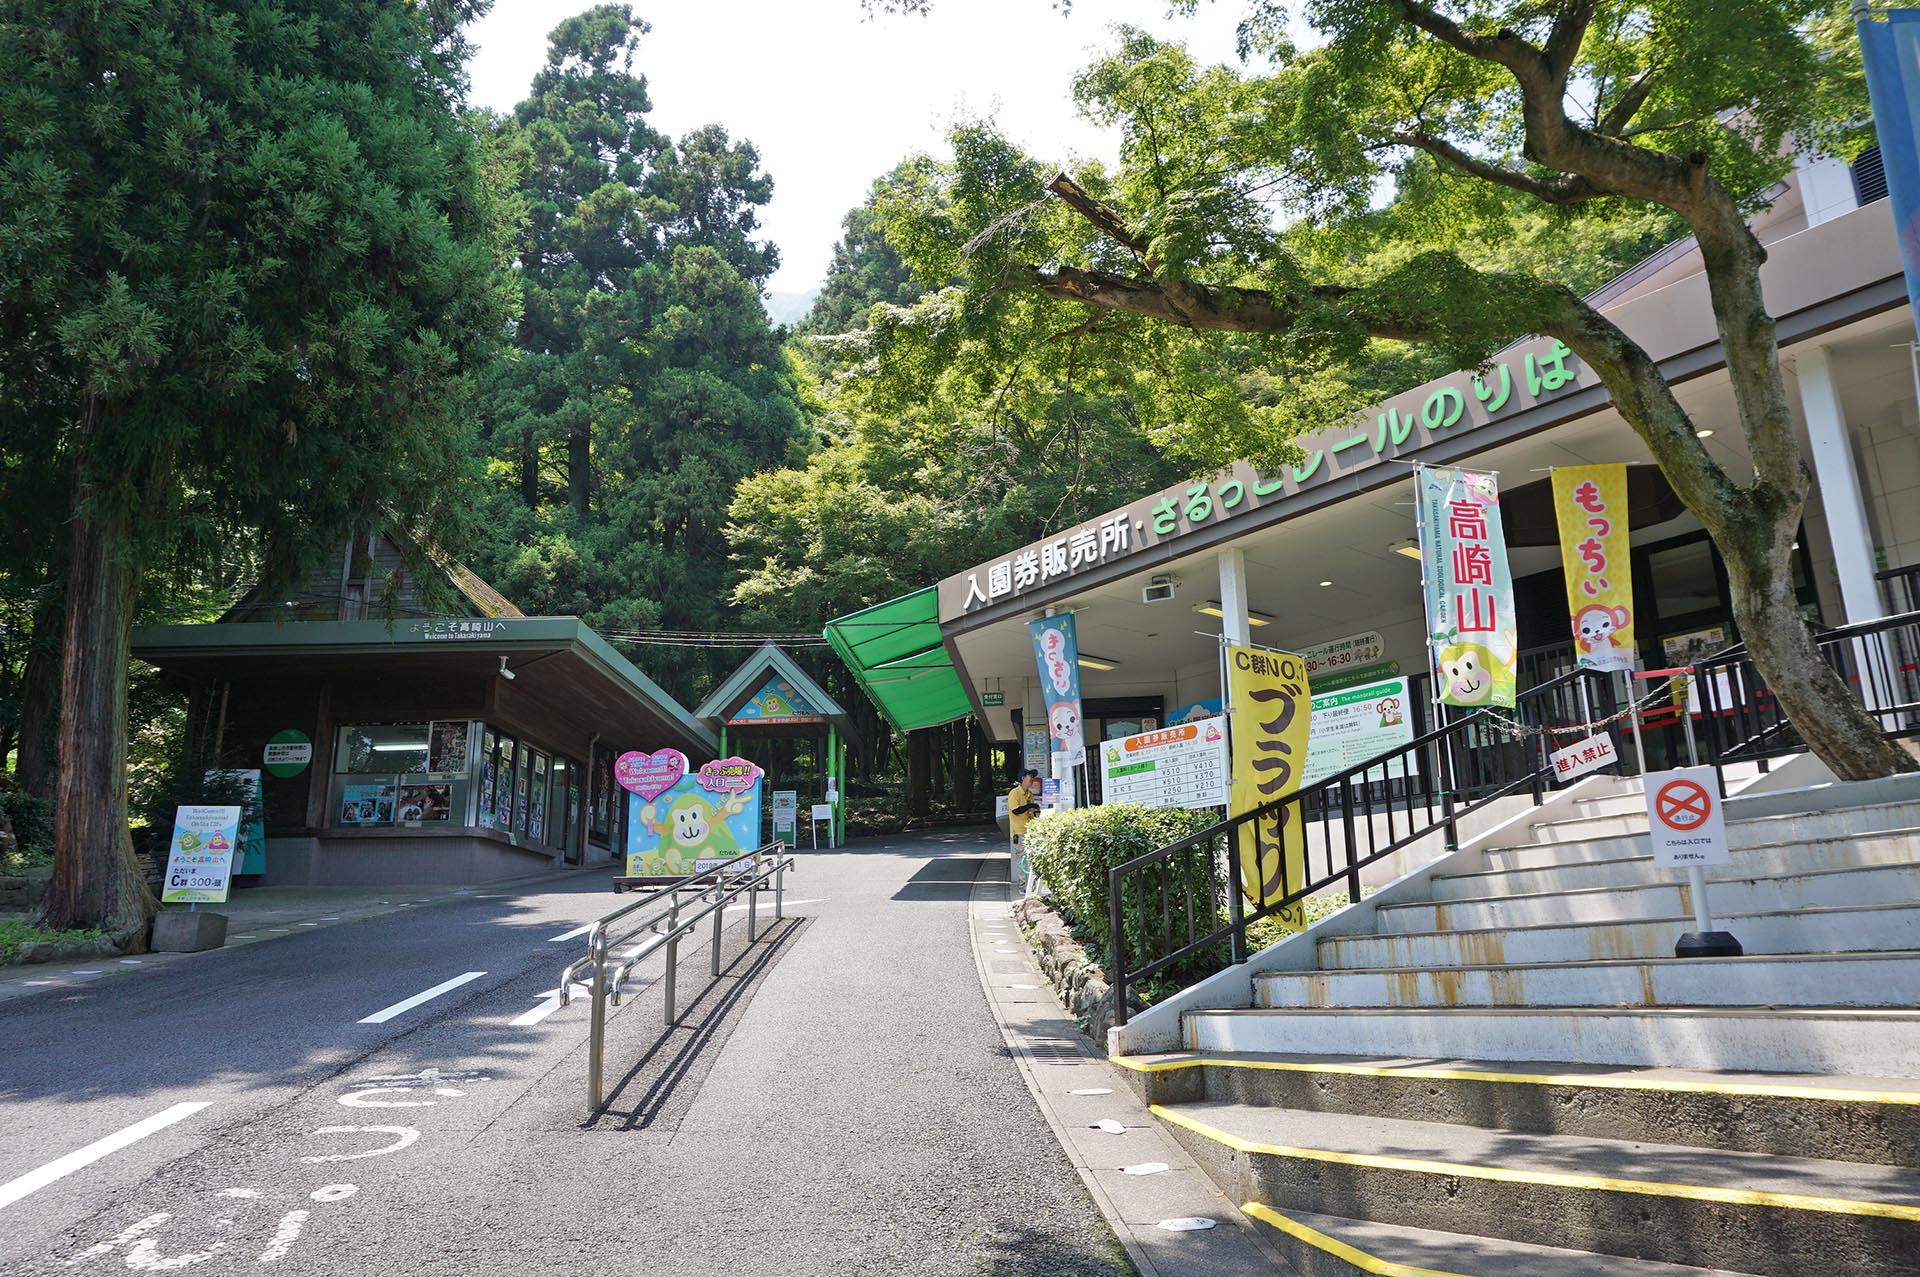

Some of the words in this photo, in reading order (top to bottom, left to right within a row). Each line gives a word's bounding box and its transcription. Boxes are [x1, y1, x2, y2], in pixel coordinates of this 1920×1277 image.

[1449, 499, 1496, 633] 高崎山
[409, 621, 507, 633] ようこそ高崎山へ
[1341, 695, 1351, 703] The
[1352, 691, 1375, 701] monorail
[1376, 687, 1391, 697] guide
[1353, 703, 1373, 713] 16:50
[1556, 743, 1611, 773] 進入禁止
[707, 778, 725, 788] 入口
[1665, 837, 1712, 847] こちらは入口では
[173, 867, 197, 875] ただいま
